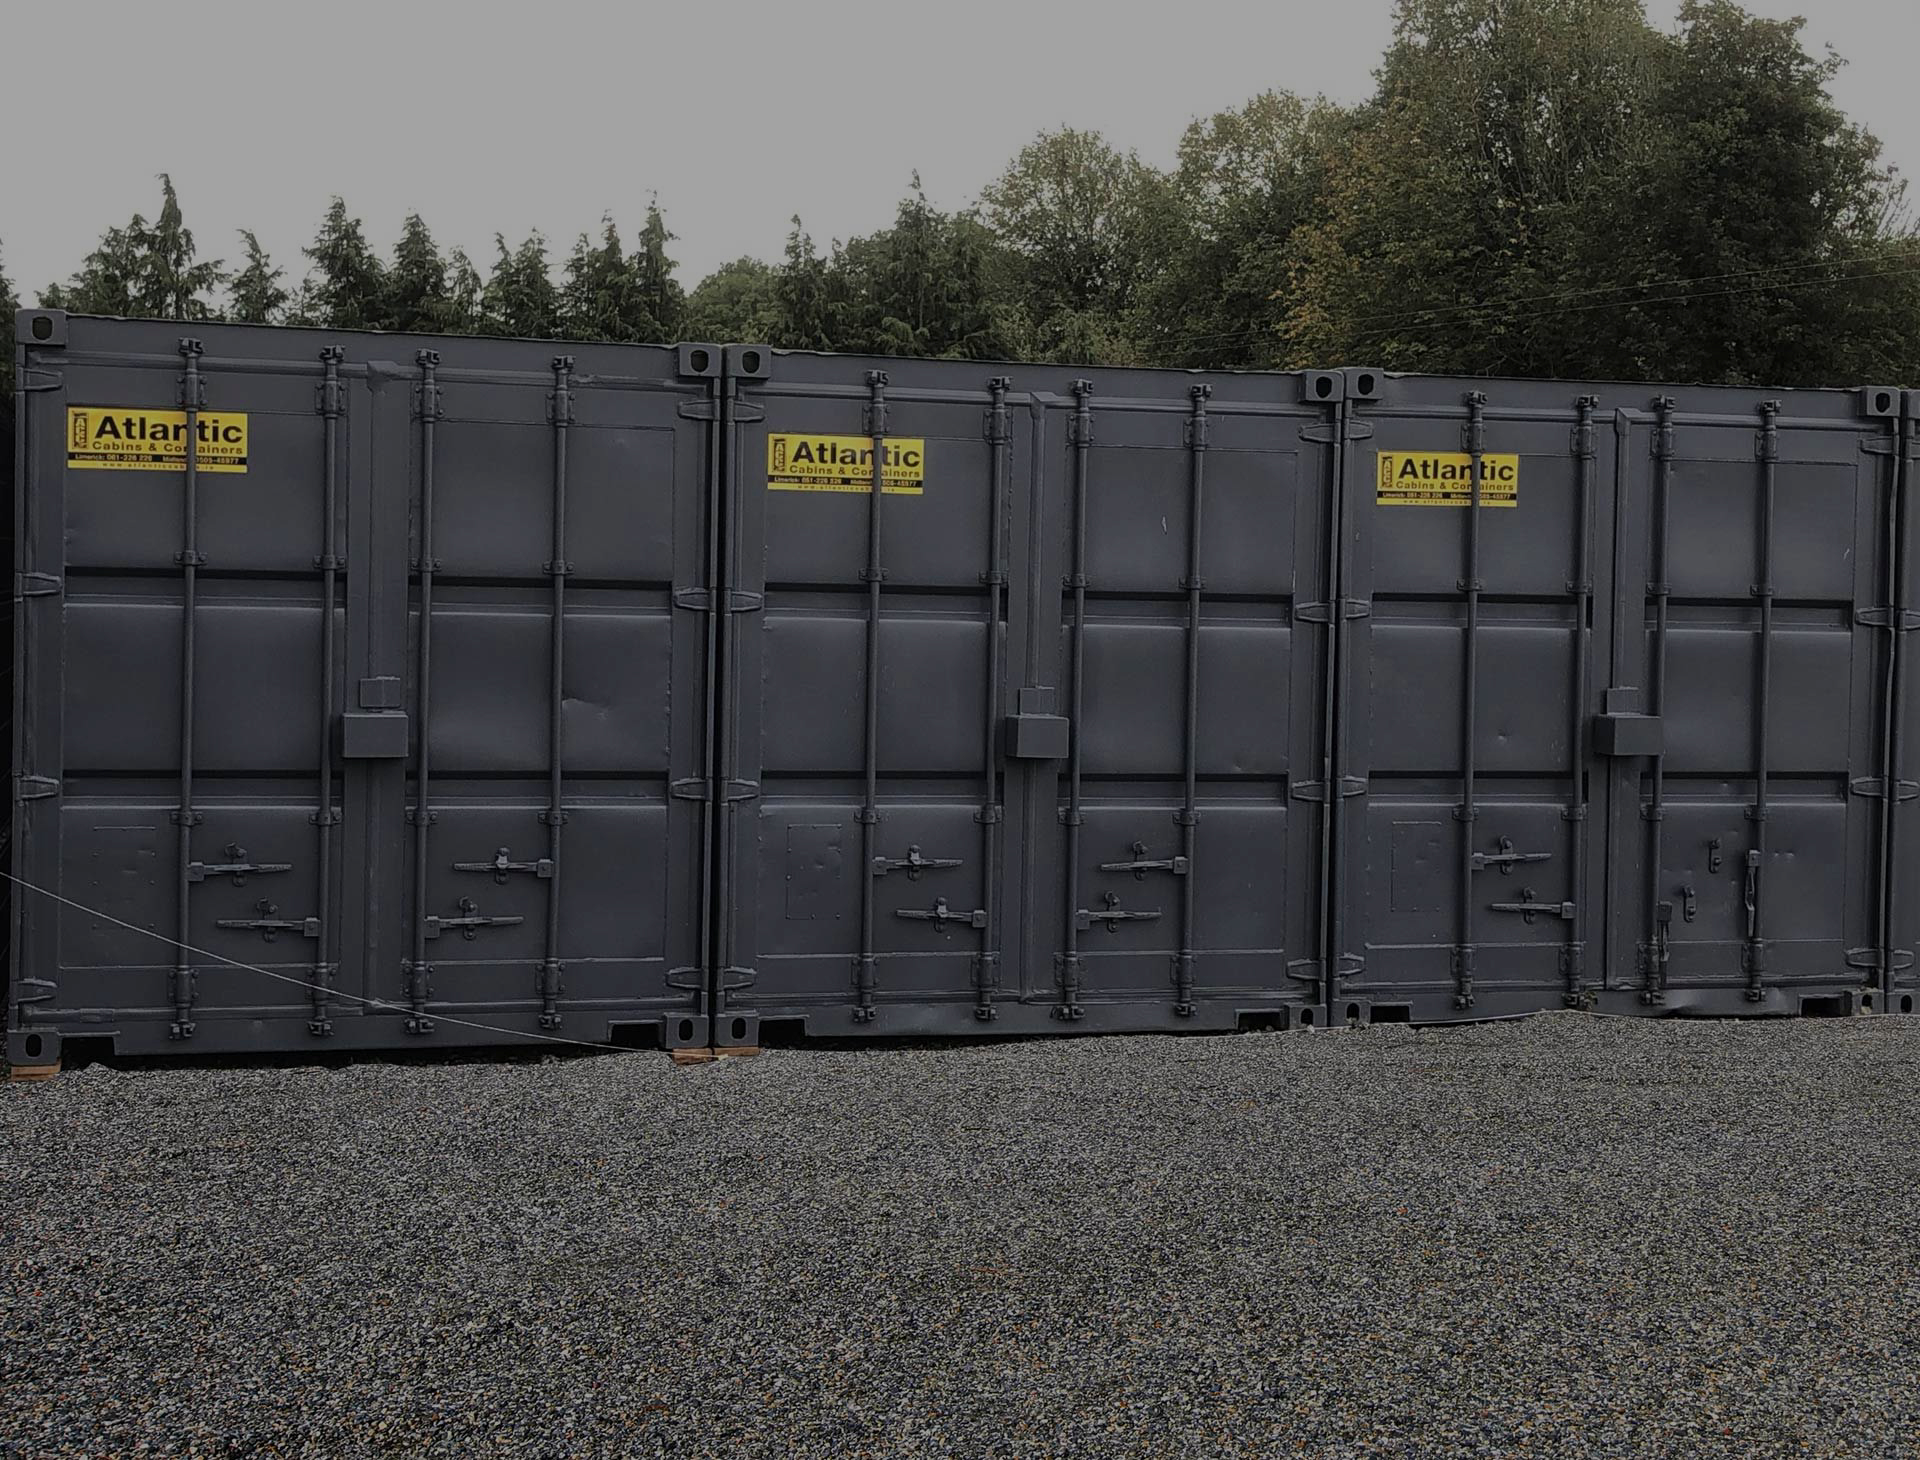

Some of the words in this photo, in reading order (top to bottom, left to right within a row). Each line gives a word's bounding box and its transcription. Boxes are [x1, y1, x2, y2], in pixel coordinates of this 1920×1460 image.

[94, 416, 243, 443] Atlantic
[92, 441, 142, 452] Cabins
[148, 443, 156, 452] &
[164, 443, 243, 454] Coainers
[792, 442, 920, 468] Atlantic
[790, 464, 832, 474] Cabins
[838, 467, 846, 475] &
[852, 467, 920, 478] Conainers
[1398, 458, 1514, 480] Atlantic
[1396, 481, 1434, 490] Cabins
[1452, 482, 1514, 490] Conainers
